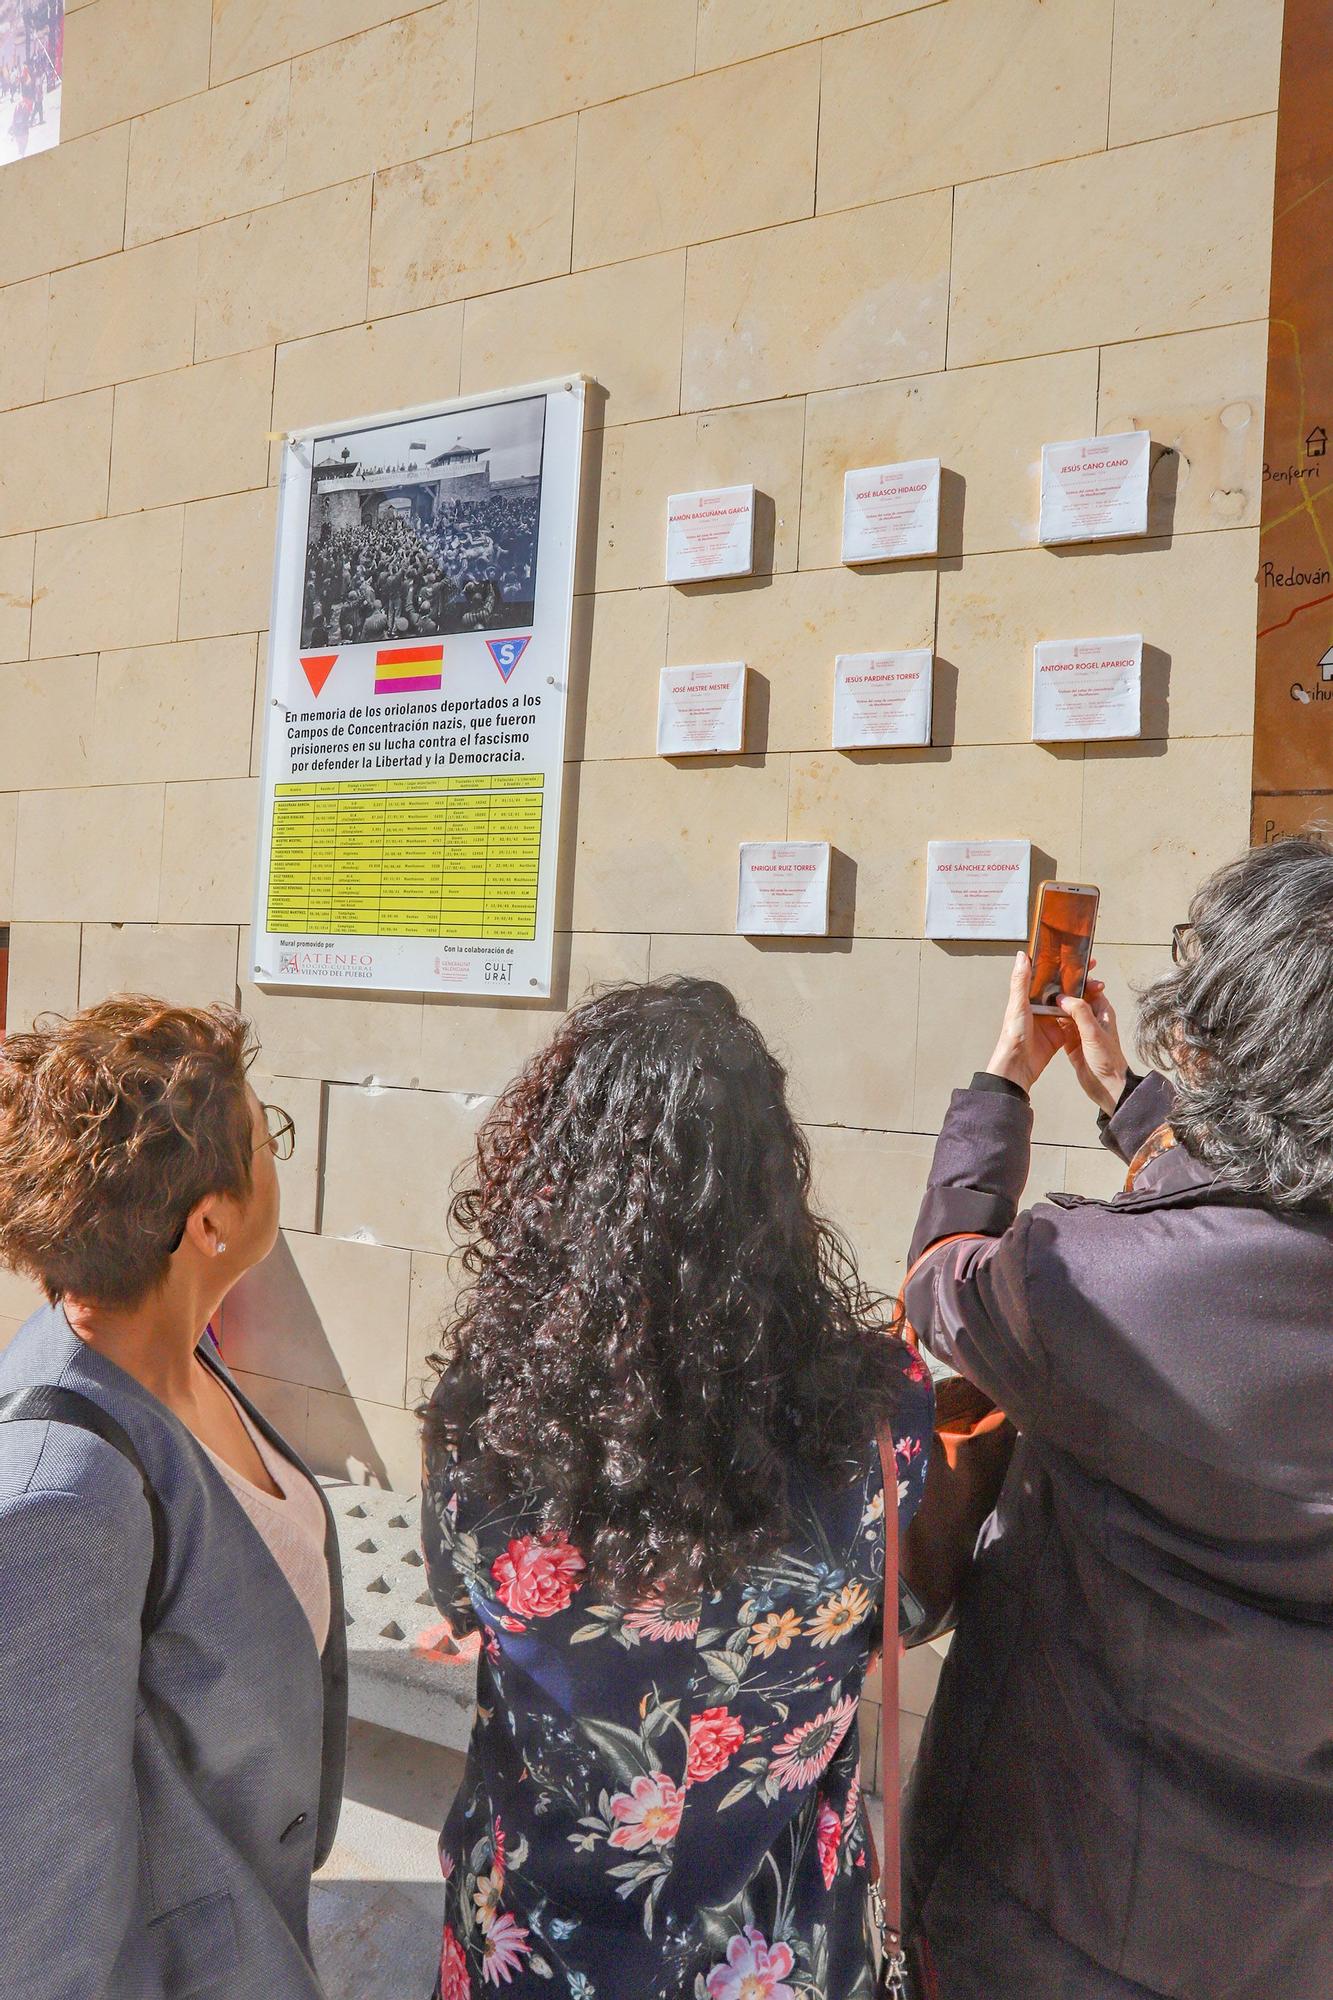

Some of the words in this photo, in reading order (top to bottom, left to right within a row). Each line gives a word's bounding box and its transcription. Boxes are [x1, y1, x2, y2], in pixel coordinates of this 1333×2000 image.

[1060, 464, 1080, 474] JESÚS
[1082, 462, 1104, 471] CANO
[1106, 459, 1128, 468] CANO
[1262, 463, 1320, 485] Benferri
[872, 488, 897, 498] BLASCO
[898, 484, 928, 494] HIDALGO
[1262, 562, 1330, 588] Redován
[500, 644, 514, 664] S
[1040, 664, 1074, 672] ANTONIO
[1076, 662, 1100, 670] ROGEL
[1101, 660, 1134, 668] APARICIO
[864, 674, 895, 682] PARDINES
[286, 712, 298, 723] En
[300, 708, 346, 722] memoria
[349, 706, 362, 718] de
[366, 705, 381, 718] los
[384, 702, 438, 716] oriolanos
[440, 696, 508, 713] deportados
[512, 697, 520, 707] a
[523, 694, 542, 706] los
[287, 726, 328, 740] Campos
[332, 724, 344, 737] de
[348, 718, 429, 736] Concentración
[432, 717, 466, 732] nazis,
[470, 716, 492, 734] que
[496, 714, 536, 727] fueron
[290, 742, 350, 758] prisioneros
[352, 741, 366, 752] en
[368, 740, 382, 751] su
[384, 737, 416, 750] lucha
[418, 735, 456, 748] contra
[460, 734, 470, 746] el
[474, 731, 530, 746] fascismo
[292, 760, 310, 774] por
[311, 757, 360, 770] defender
[362, 756, 372, 768] la
[376, 753, 422, 768] Libertad
[426, 754, 432, 768] y
[434, 752, 445, 765] la
[450, 748, 525, 765] Democracia.
[464, 946, 505, 954] colaboración
[302, 953, 373, 966] ATENEO
[344, 970, 373, 978] PUEBLO
